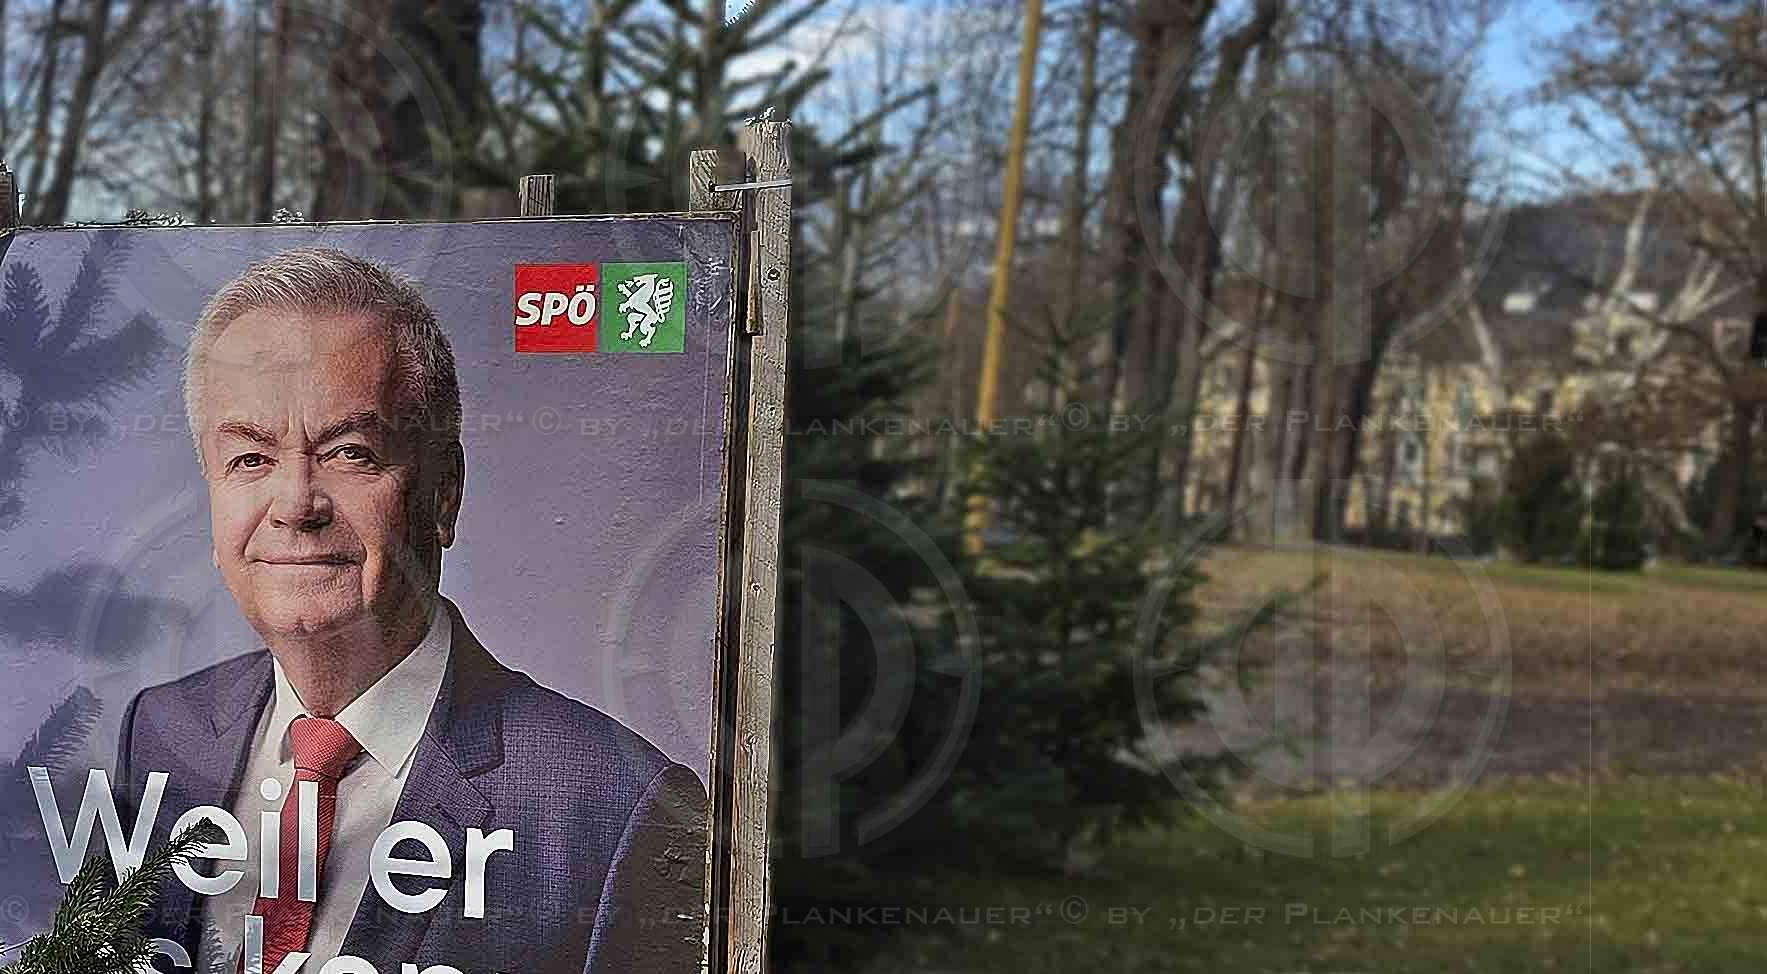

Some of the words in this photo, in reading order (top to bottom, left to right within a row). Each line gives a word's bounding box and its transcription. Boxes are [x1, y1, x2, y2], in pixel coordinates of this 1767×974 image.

[515, 285, 596, 326] SPÖ
[27, 766, 320, 902] Weil
[369, 820, 514, 919] er
